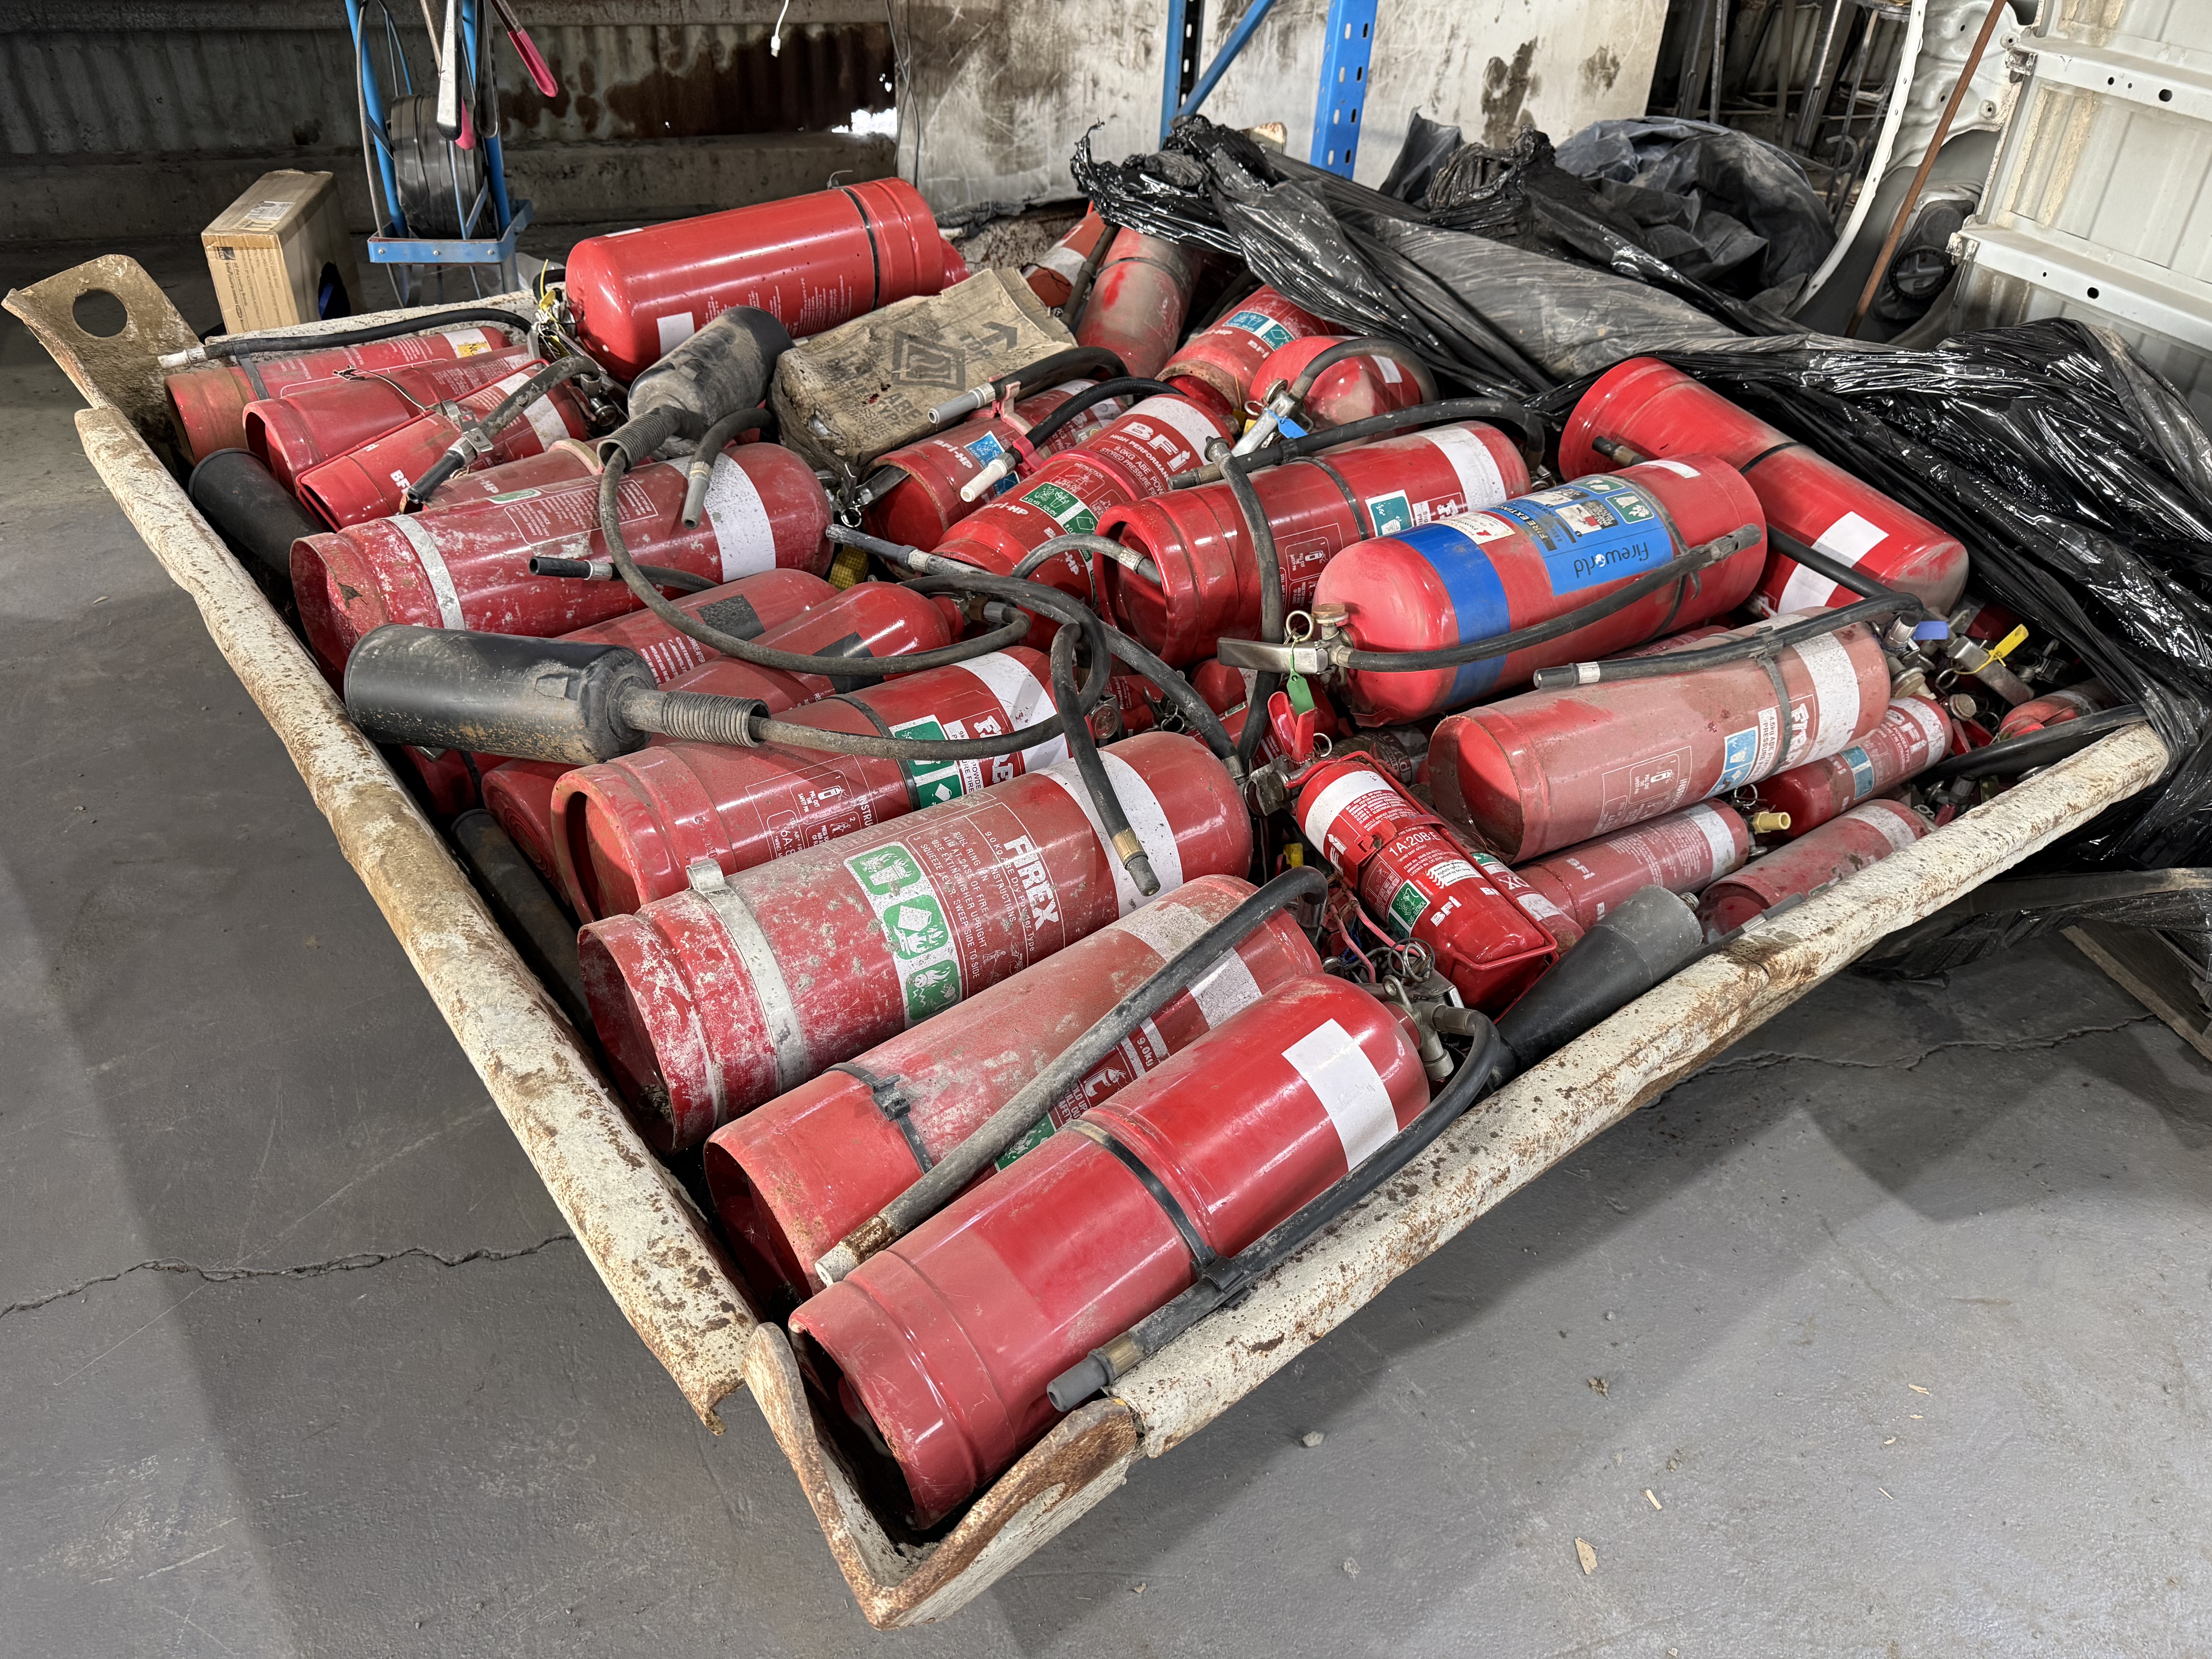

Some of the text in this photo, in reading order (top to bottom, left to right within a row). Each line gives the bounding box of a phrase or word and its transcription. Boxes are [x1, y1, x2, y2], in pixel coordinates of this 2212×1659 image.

[883, 390, 924, 424] ABE
[1109, 434, 1129, 443] HIGH
[1099, 447, 1158, 497] STORED PRESSURE FIR
[1114, 445, 1165, 494] 9.0KG ABE POW
[537, 510, 551, 525] SERVICE
[1026, 498, 1040, 507] CLASS
[1041, 505, 1058, 517] SOLIDS
[1526, 519, 1548, 539] FIRE
[1759, 722, 1768, 760] PRESSURE
[1892, 727, 1908, 749] POWDER
[970, 761, 981, 790] POWDE
[797, 793, 807, 806] SAFETY
[809, 790, 817, 800] PULL
[820, 824, 828, 836] PRESS
[920, 843, 943, 871] SQUEEZE
[950, 831, 968, 847] PULL
[966, 847, 981, 866] RING
[984, 830, 997, 843] 9.0
[993, 843, 1004, 855] Kg
[1000, 857, 1015, 875] ABE
[1011, 876, 1022, 893] Dry
[942, 835, 956, 847] AIM
[951, 848, 963, 859] AT
[970, 880, 981, 893] OF
[931, 840, 987, 948] USE EXTINGUISHER UPRIGHT
[1003, 834, 1058, 931] FIREX
[953, 899, 969, 927] SWEEP
[963, 928, 974, 948] SIDE
[969, 949, 977, 960] TO
[970, 961, 979, 979] SIDE
[1136, 1036, 1156, 1067] 9.0kg
